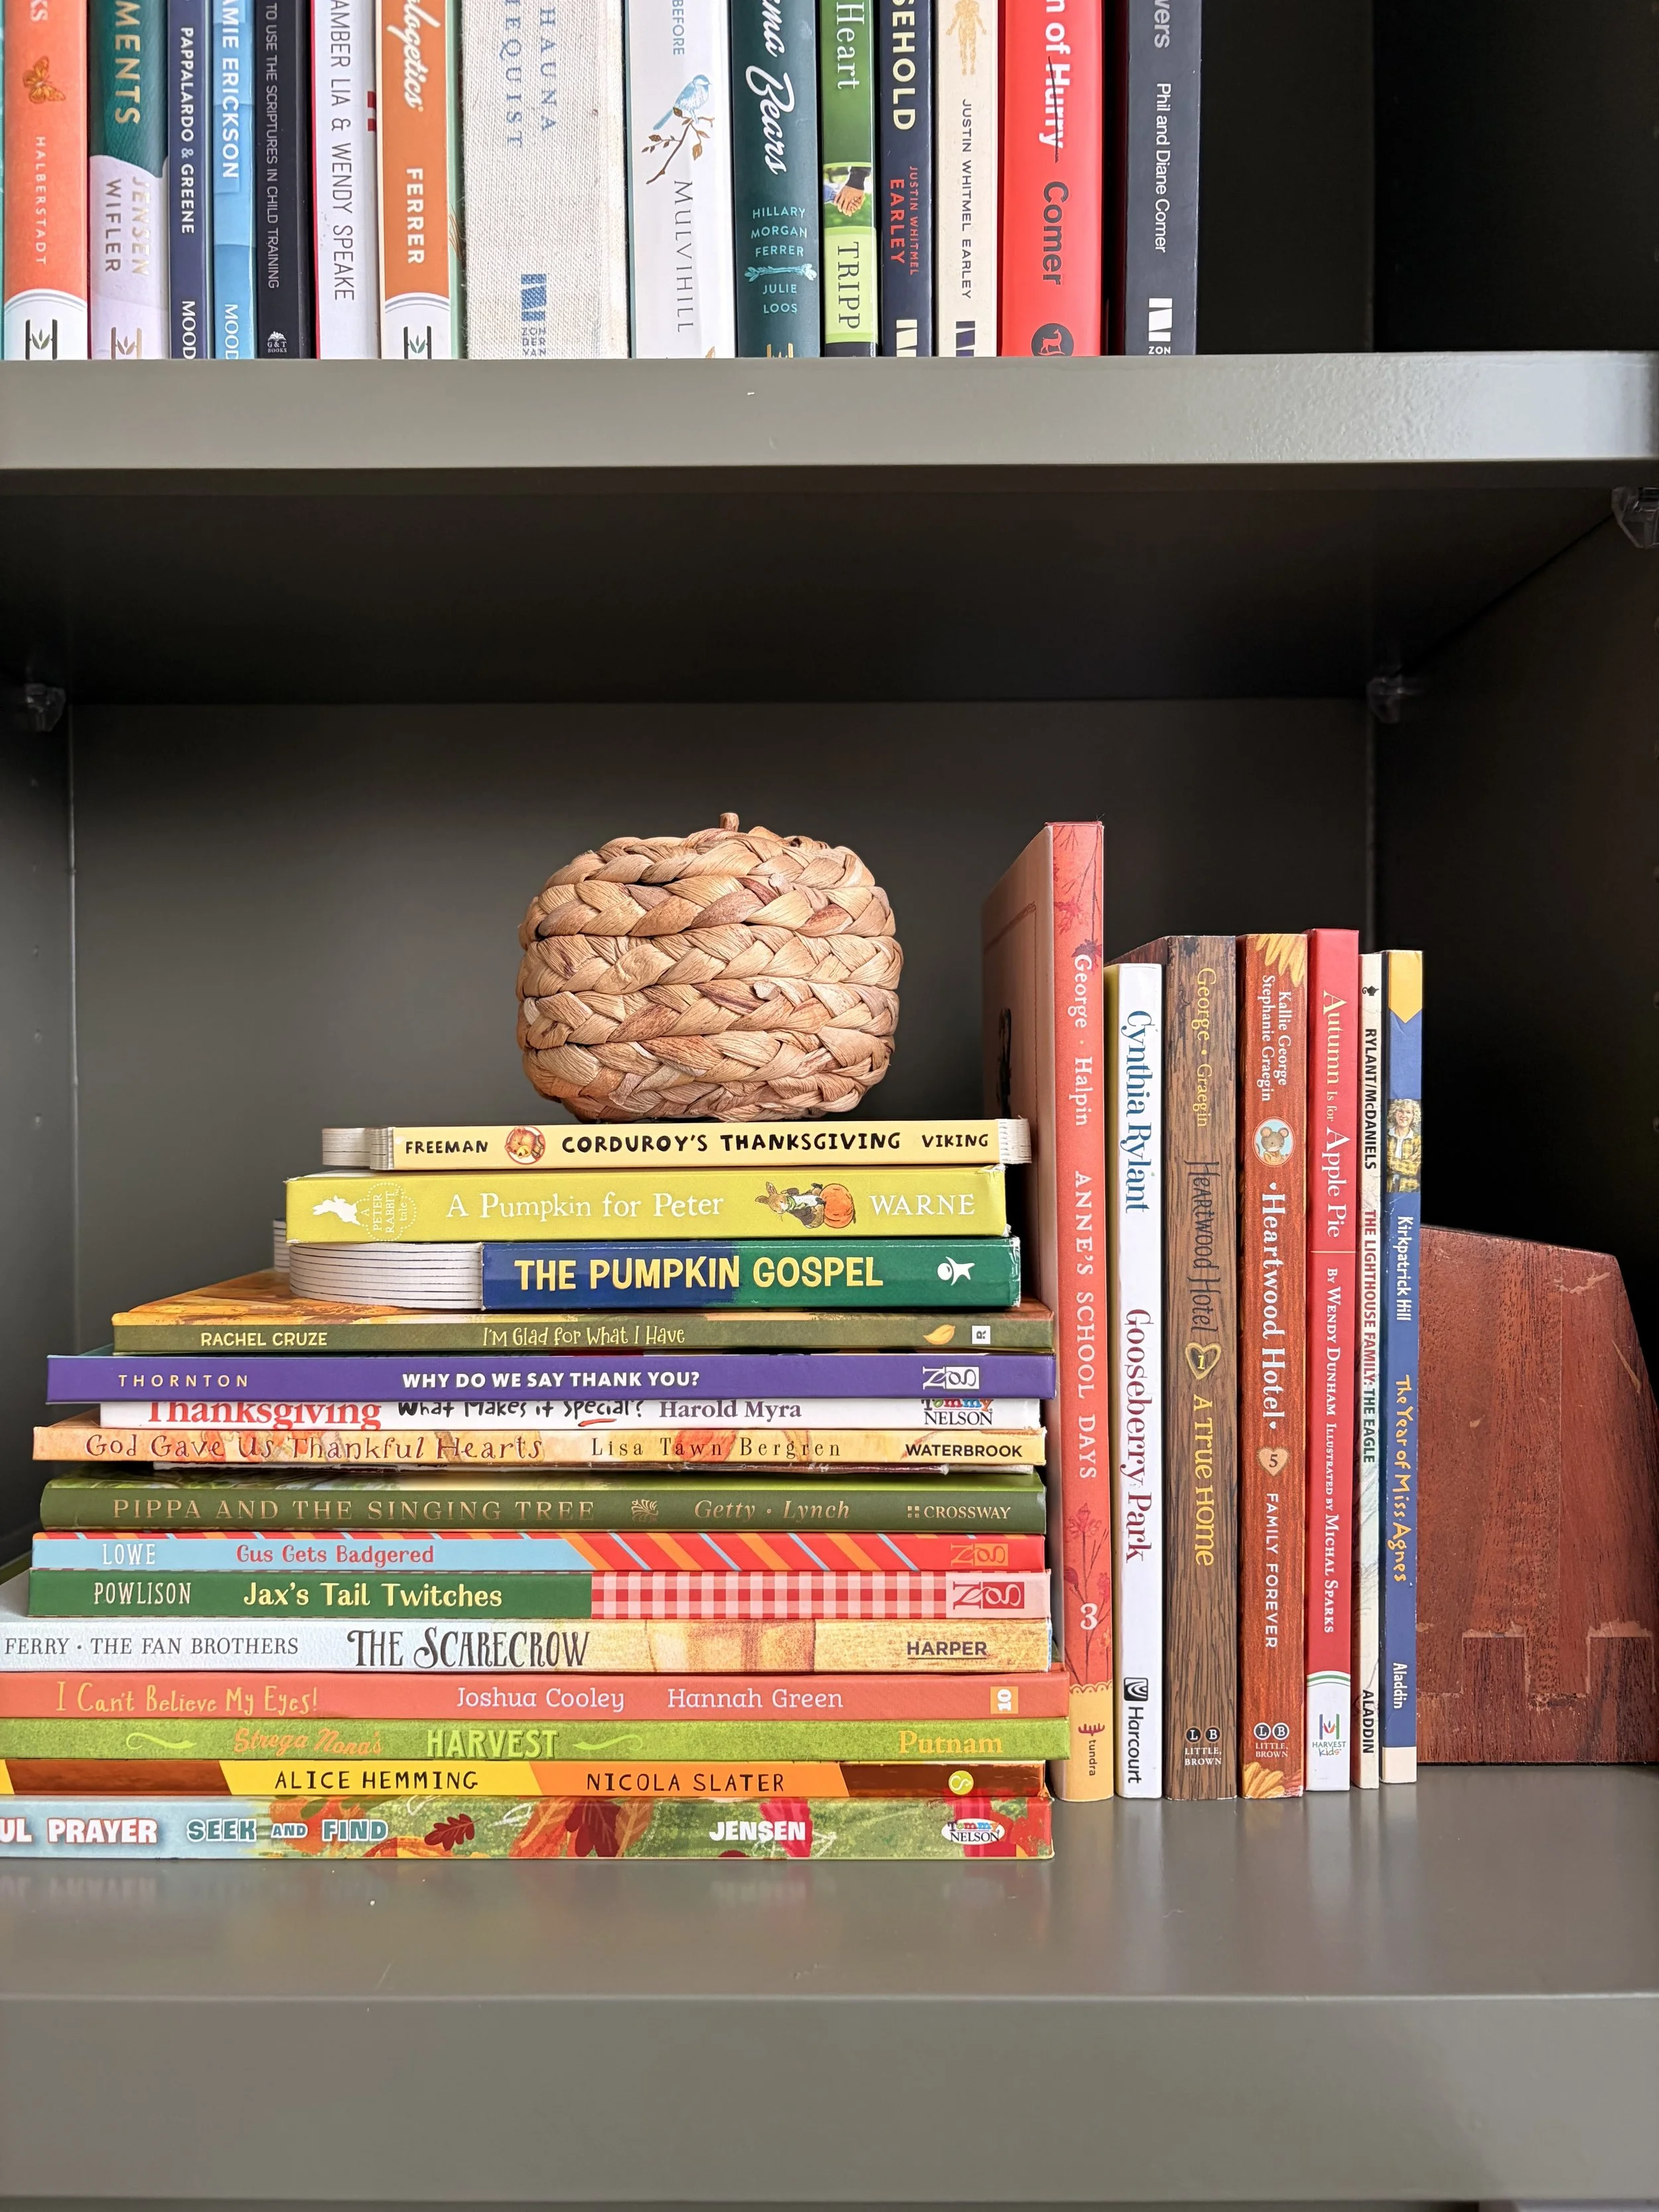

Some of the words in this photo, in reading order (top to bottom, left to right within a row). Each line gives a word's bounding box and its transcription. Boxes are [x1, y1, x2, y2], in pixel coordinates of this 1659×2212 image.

[672, 0, 685, 55] BEFORE
[836, 3, 865, 90] Heart
[180, 27, 195, 142] PAPPALARDO
[332, 80, 350, 108] LIA
[1039, 64, 1071, 149] Hurry
[1156, 82, 1171, 112] Phil
[222, 58, 240, 179] ERICKSON
[267, 85, 279, 163] SCRIPTURES
[745, 65, 795, 175] Bears
[962, 99, 972, 153] JUSTIN
[180, 164, 196, 234] GREENE
[332, 142, 353, 214] WENDY
[910, 165, 918, 210] JUSTIN
[962, 160, 972, 232] WHITMEL
[1155, 149, 1171, 195] Diane
[35, 136, 46, 265] HALBERSTADT
[105, 178, 121, 273] WIFLER
[131, 176, 150, 276] JENSEN
[267, 186, 279, 224] CHILD
[406, 167, 425, 265] FERRER
[753, 207, 806, 219] HILLARY
[890, 179, 905, 264] EARLEY
[1154, 198, 1171, 254] Comer
[267, 229, 280, 289] TRAINING
[674, 181, 694, 332] MULVIHILL
[751, 226, 808, 239] MORGAN
[755, 245, 804, 257] FERRER
[910, 216, 919, 276] WHITMEL
[1042, 181, 1069, 286] Comer
[333, 225, 354, 302] SPEAKE
[762, 283, 797, 295] JULIE
[837, 242, 861, 329] TRIPP
[961, 239, 972, 299] EARLEY
[763, 303, 798, 313] LOOS
[1067, 954, 1093, 1029] George
[1191, 967, 1217, 1041] George
[1257, 974, 1276, 1042] Stephanie
[1278, 991, 1293, 1032] Kallie
[1119, 1009, 1153, 1117] Cynthia
[1273, 1035, 1291, 1086] George
[1323, 989, 1348, 1085] Autumn
[1068, 1056, 1094, 1127] Halpin
[1192, 1063, 1213, 1128] Graegin
[1257, 1046, 1275, 1102] Graegin
[1365, 1028, 1378, 1170] RYLANT/McDANIELS
[405, 1140, 489, 1155] FREEMAN
[561, 1134, 708, 1153] CORDUROY'S
[720, 1131, 901, 1151] THANKSGIVING
[921, 1133, 989, 1148] VIKING
[1119, 1122, 1152, 1214] Rylant
[1321, 1126, 1350, 1197] Apple
[372, 1193, 383, 1231] PETER
[397, 1202, 408, 1221] tale
[480, 1191, 592, 1222] Pumpkin
[653, 1192, 725, 1218] Peter
[868, 1193, 975, 1217] WARNE
[1074, 1171, 1093, 1276] ANNE'S
[1327, 1201, 1347, 1238] Pie
[589, 1254, 740, 1291] PUMPKIN
[752, 1256, 884, 1289] GOSPEL
[1262, 1193, 1286, 1339] Heartwood
[1364, 1238, 1377, 1329] LIGHTHOUSE
[1392, 1215, 1414, 1297] Kirkpatrick
[1187, 1276, 1220, 1333] Hotel
[1396, 1298, 1413, 1321] Hill
[200, 1332, 267, 1347] RACHEL
[271, 1331, 328, 1347] CRUZE
[512, 1326, 549, 1347] Glad
[587, 1325, 629, 1346] What
[644, 1325, 685, 1345] Have
[1076, 1291, 1096, 1399] SCHOOL
[1363, 1331, 1376, 1386] FAMILY:
[118, 1374, 249, 1388] THORNTON
[401, 1372, 451, 1388] WHY
[569, 1372, 642, 1388] THANK
[647, 1371, 701, 1387] YOU?
[920, 1398, 994, 1412] Tommy
[1119, 1309, 1154, 1485] Gooseberry
[1262, 1347, 1286, 1418] Hotel
[148, 1401, 382, 1431] Thanksgiving
[659, 1400, 737, 1419] Harold
[744, 1400, 802, 1423] Myra
[923, 1411, 993, 1426] NELSON
[1396, 1406, 1413, 1446] Year
[86, 1434, 137, 1457] God
[151, 1434, 225, 1458] Gave
[287, 1436, 424, 1459] Thankful
[437, 1437, 543, 1460] Hearts
[591, 1437, 644, 1457] Lisa
[660, 1437, 723, 1457] Tawn
[739, 1437, 841, 1461] Bergren
[904, 1443, 1023, 1459] WATERBROOK
[1078, 1414, 1097, 1479] DAYS
[1362, 1420, 1376, 1464] EAGLE
[112, 1499, 202, 1518] PIPPA
[367, 1500, 501, 1520] SINGING
[515, 1501, 595, 1520] TREE
[693, 1500, 757, 1522] Getty
[782, 1500, 850, 1524] Lynch
[923, 1505, 1011, 1520] CROSSWAY
[1392, 1473, 1411, 1518] Miss
[1127, 1491, 1152, 1563] Park
[1265, 1493, 1279, 1555] FAMILY
[102, 1543, 156, 1566] LOWE
[236, 1544, 274, 1564] Gus
[281, 1544, 328, 1564] Gets
[335, 1544, 435, 1568] Badgered
[1386, 1522, 1412, 1583] Agnes
[93, 1582, 192, 1605] POWLISON
[243, 1582, 309, 1607] Jax's
[319, 1582, 371, 1607] Tail
[381, 1582, 503, 1607] Twitches
[1265, 1562, 1279, 1649] FOREVER
[5, 1637, 70, 1655] FERRY
[141, 1637, 182, 1655] FAN
[190, 1637, 299, 1655] BROTHERS
[906, 1641, 987, 1656] HARPER
[76, 1681, 135, 1713] Can't
[145, 1684, 218, 1712] Believe
[264, 1685, 319, 1716] Eyes!
[456, 1686, 538, 1708] Joshua
[545, 1687, 626, 1713] Cooley
[667, 1688, 763, 1709] Hannah
[771, 1688, 844, 1709] Green
[1392, 1662, 1407, 1710] Aladdin
[234, 1728, 309, 1757] Strega
[313, 1728, 382, 1757] Nona's
[427, 1729, 560, 1760] HARVEST
[898, 1730, 1003, 1755] Putnam
[1127, 1706, 1144, 1785] Harcourt
[1362, 1690, 1374, 1754] ALADDIN
[273, 1770, 350, 1790] ALICE
[362, 1771, 479, 1791] HEMMING
[586, 1773, 681, 1793] NICOLA
[692, 1773, 784, 1793] SLATER
[1088, 1739, 1098, 1777] tundra
[1185, 1757, 1222, 1766] BROWN
[47, 1818, 159, 1844] PRAYER
[186, 1818, 258, 1843] SEEK
[321, 1818, 389, 1842] FIND
[708, 1820, 806, 1842] JENSEN
[947, 1820, 1000, 1832] Tommy
[950, 1830, 1000, 1842] NELSON
